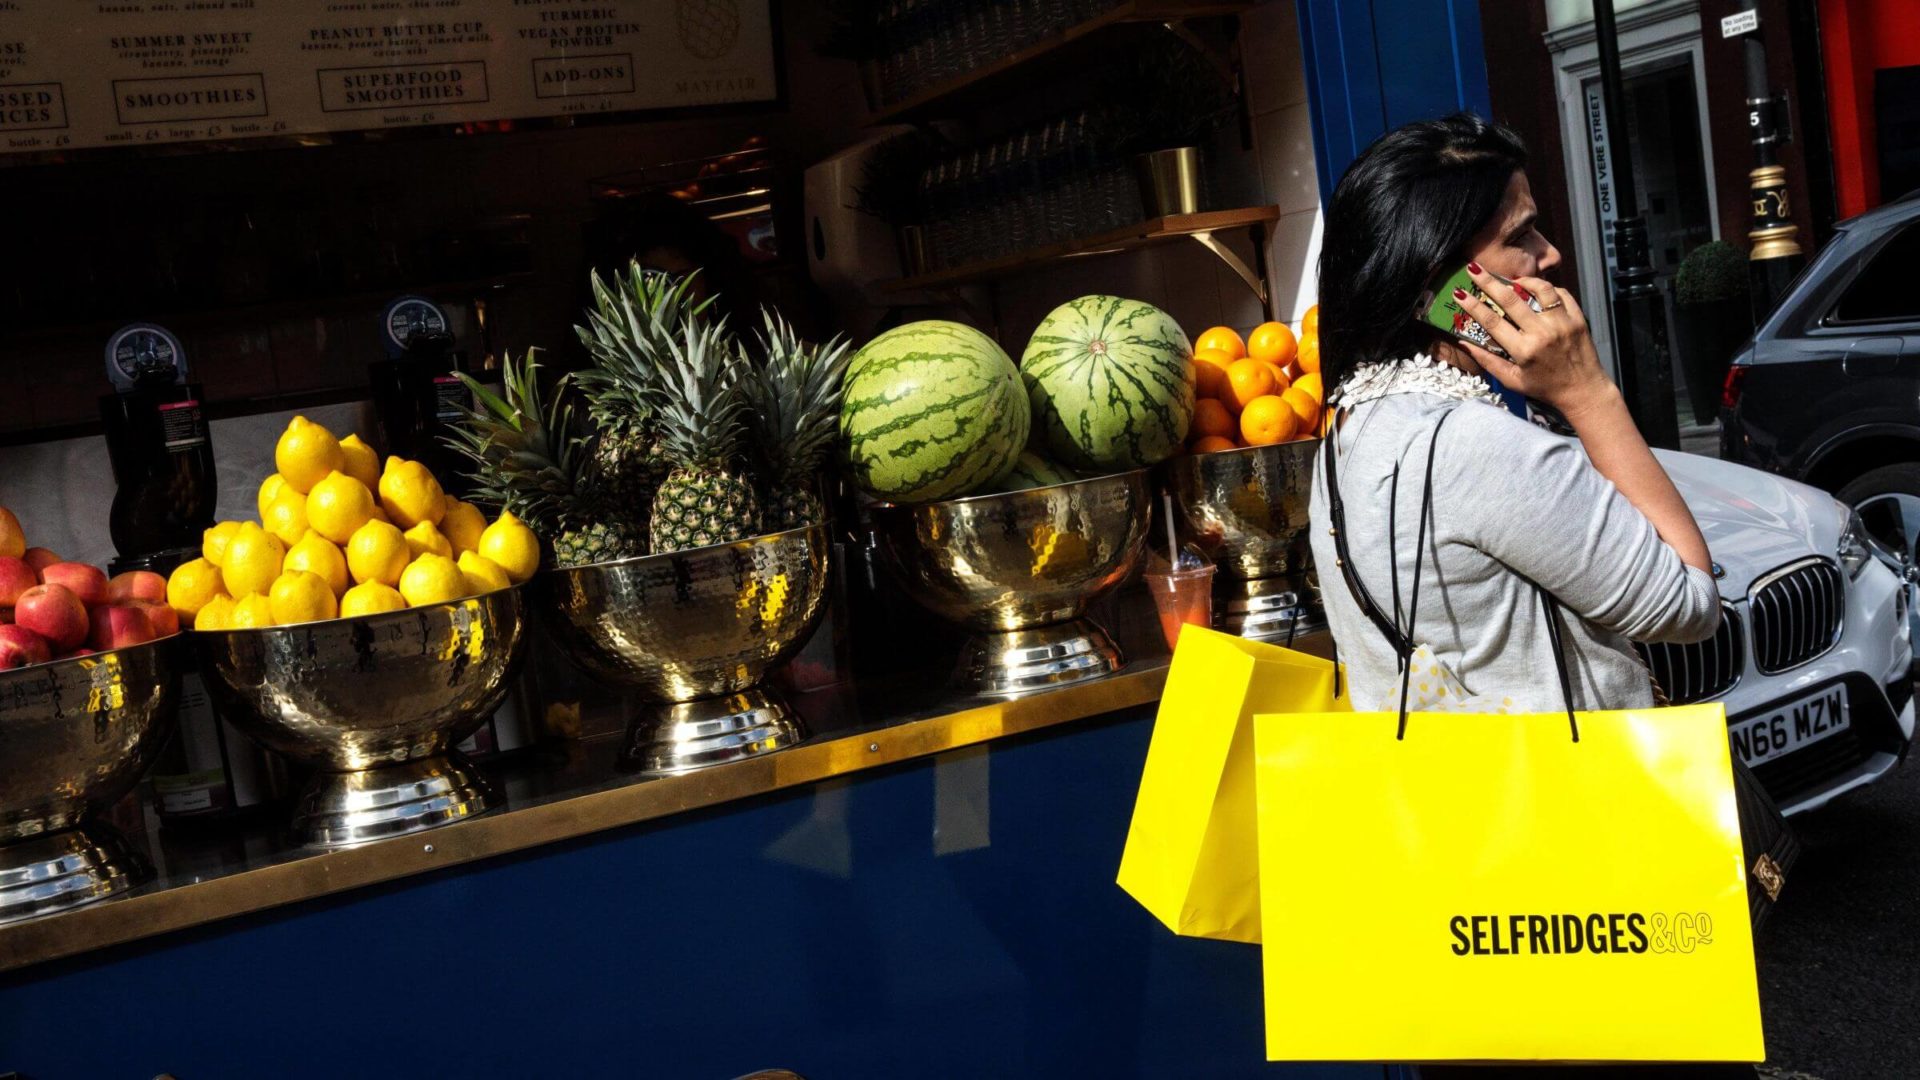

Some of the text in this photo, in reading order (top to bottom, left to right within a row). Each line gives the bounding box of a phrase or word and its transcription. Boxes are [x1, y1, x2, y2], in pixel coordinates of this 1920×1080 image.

[539, 9, 617, 22] TURMERIC
[310, 21, 483, 40] PEANUT BUTTER CUP
[518, 23, 641, 39] VEGAN PROTEIN
[0, 43, 26, 54] SE
[111, 32, 252, 48] SUMMER SWEET
[550, 36, 614, 49] POWDER
[344, 69, 462, 88] SUPERFOOD
[542, 66, 625, 83] ADD-ONS
[675, 77, 755, 94] MAYFAIR
[126, 88, 256, 108] SMOOTHIES
[346, 85, 464, 104] SMOOTHIES
[1750, 111, 1760, 127] 5
[104, 131, 134, 142] small
[145, 129, 160, 141] £4
[169, 127, 196, 140] large
[208, 125, 223, 137] £5
[231, 123, 262, 134] bottle
[272, 121, 287, 133] £6
[9, 137, 41, 147] bottle
[1589, 93, 1612, 213] ONE VERE STREET
[1793, 690, 1843, 743] MZW
